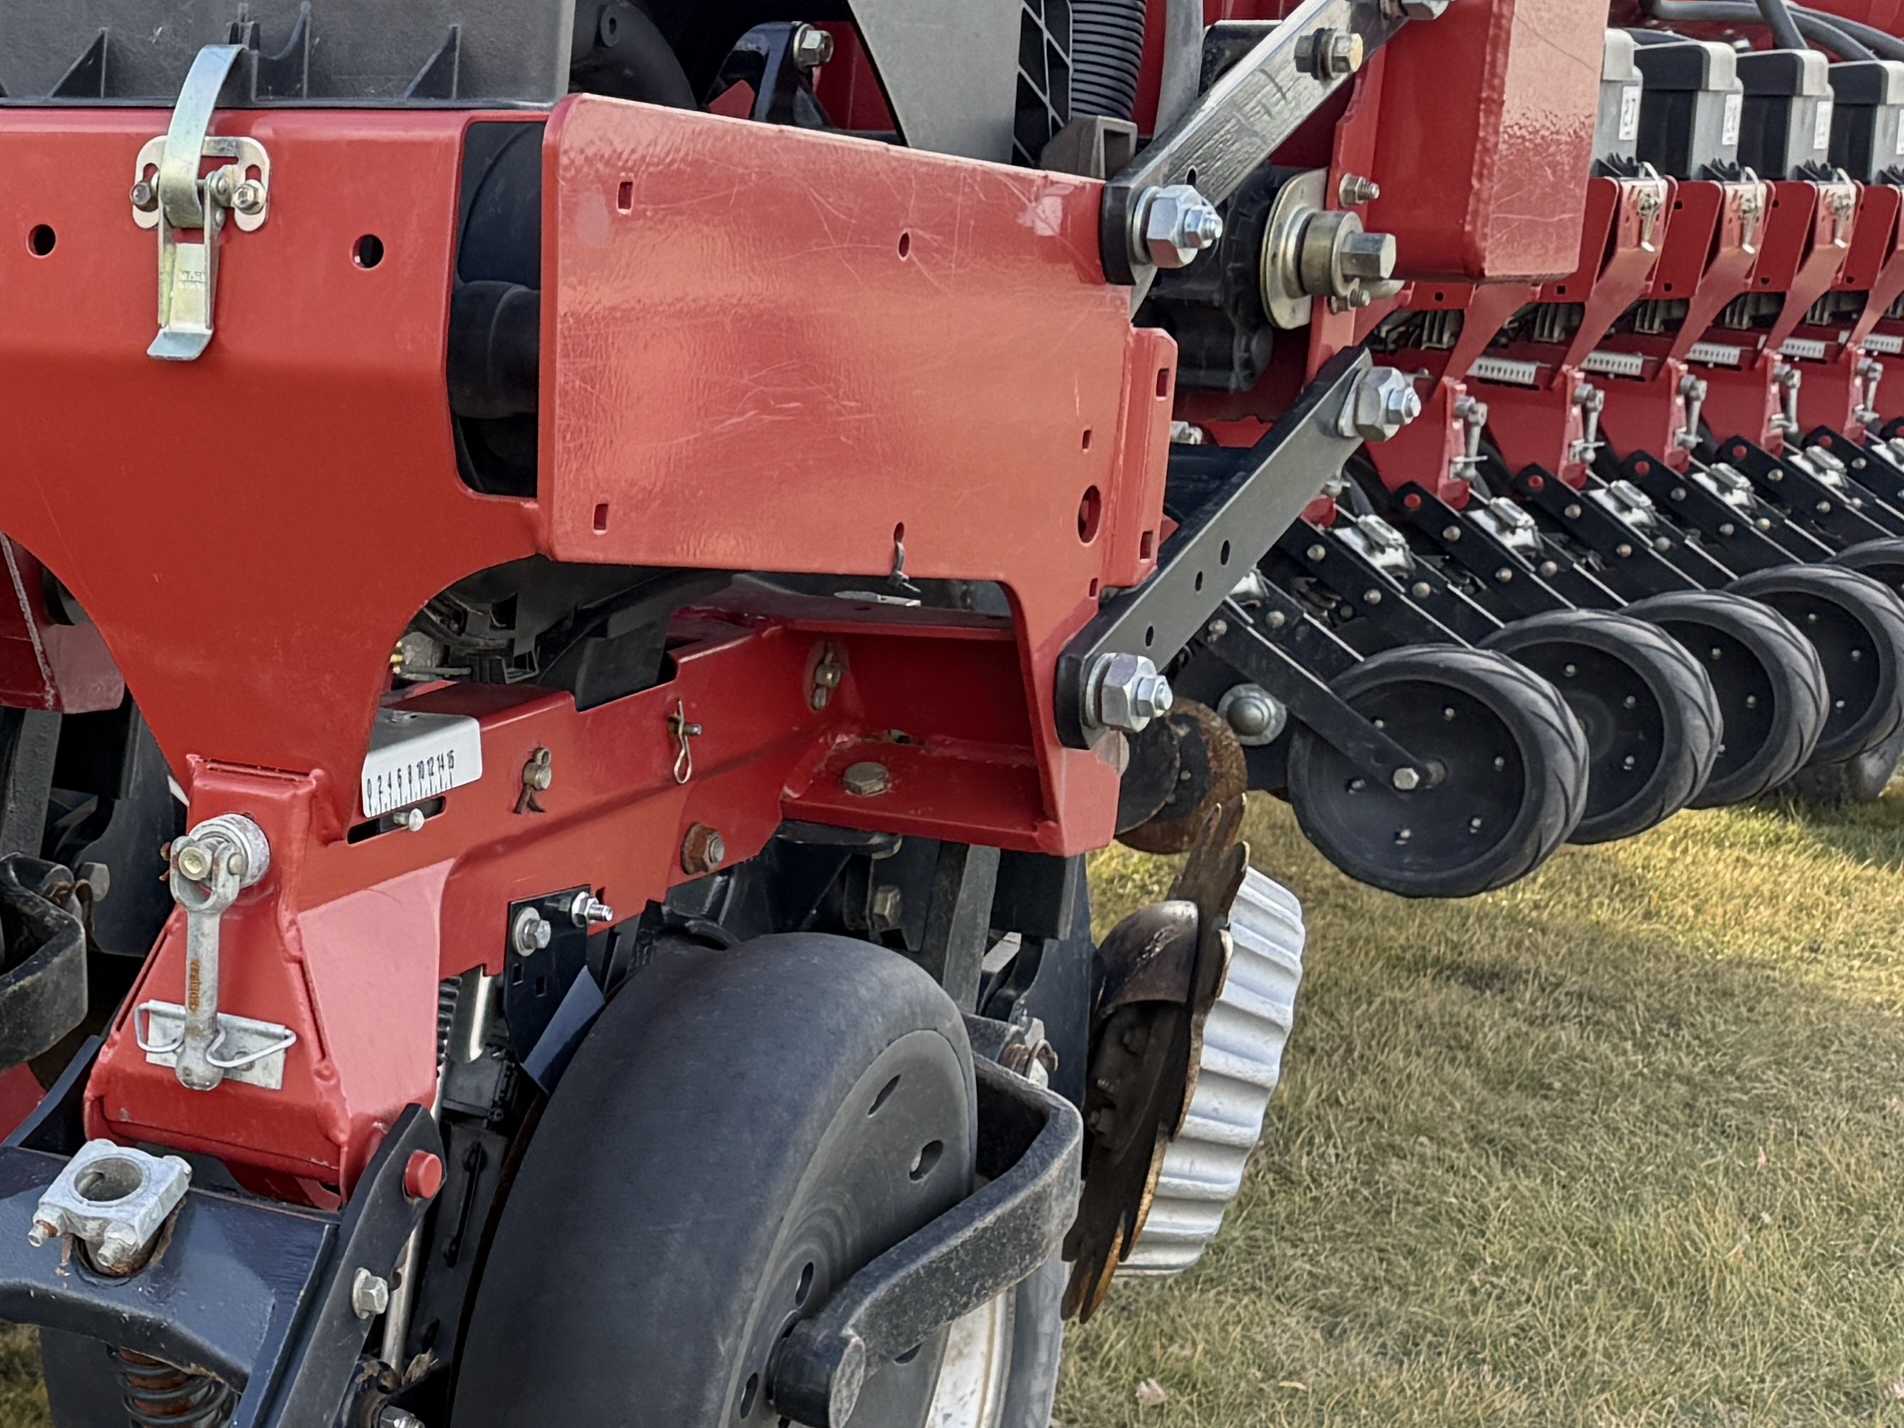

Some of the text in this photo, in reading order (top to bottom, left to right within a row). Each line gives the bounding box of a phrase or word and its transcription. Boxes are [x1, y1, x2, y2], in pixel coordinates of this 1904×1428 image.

[367, 778, 372, 797] 0
[377, 776, 383, 793] 2
[387, 772, 392, 790] 4
[408, 764, 412, 784] 8
[417, 761, 425, 779] 10
[427, 757, 435, 776] 12
[437, 753, 445, 772] 14
